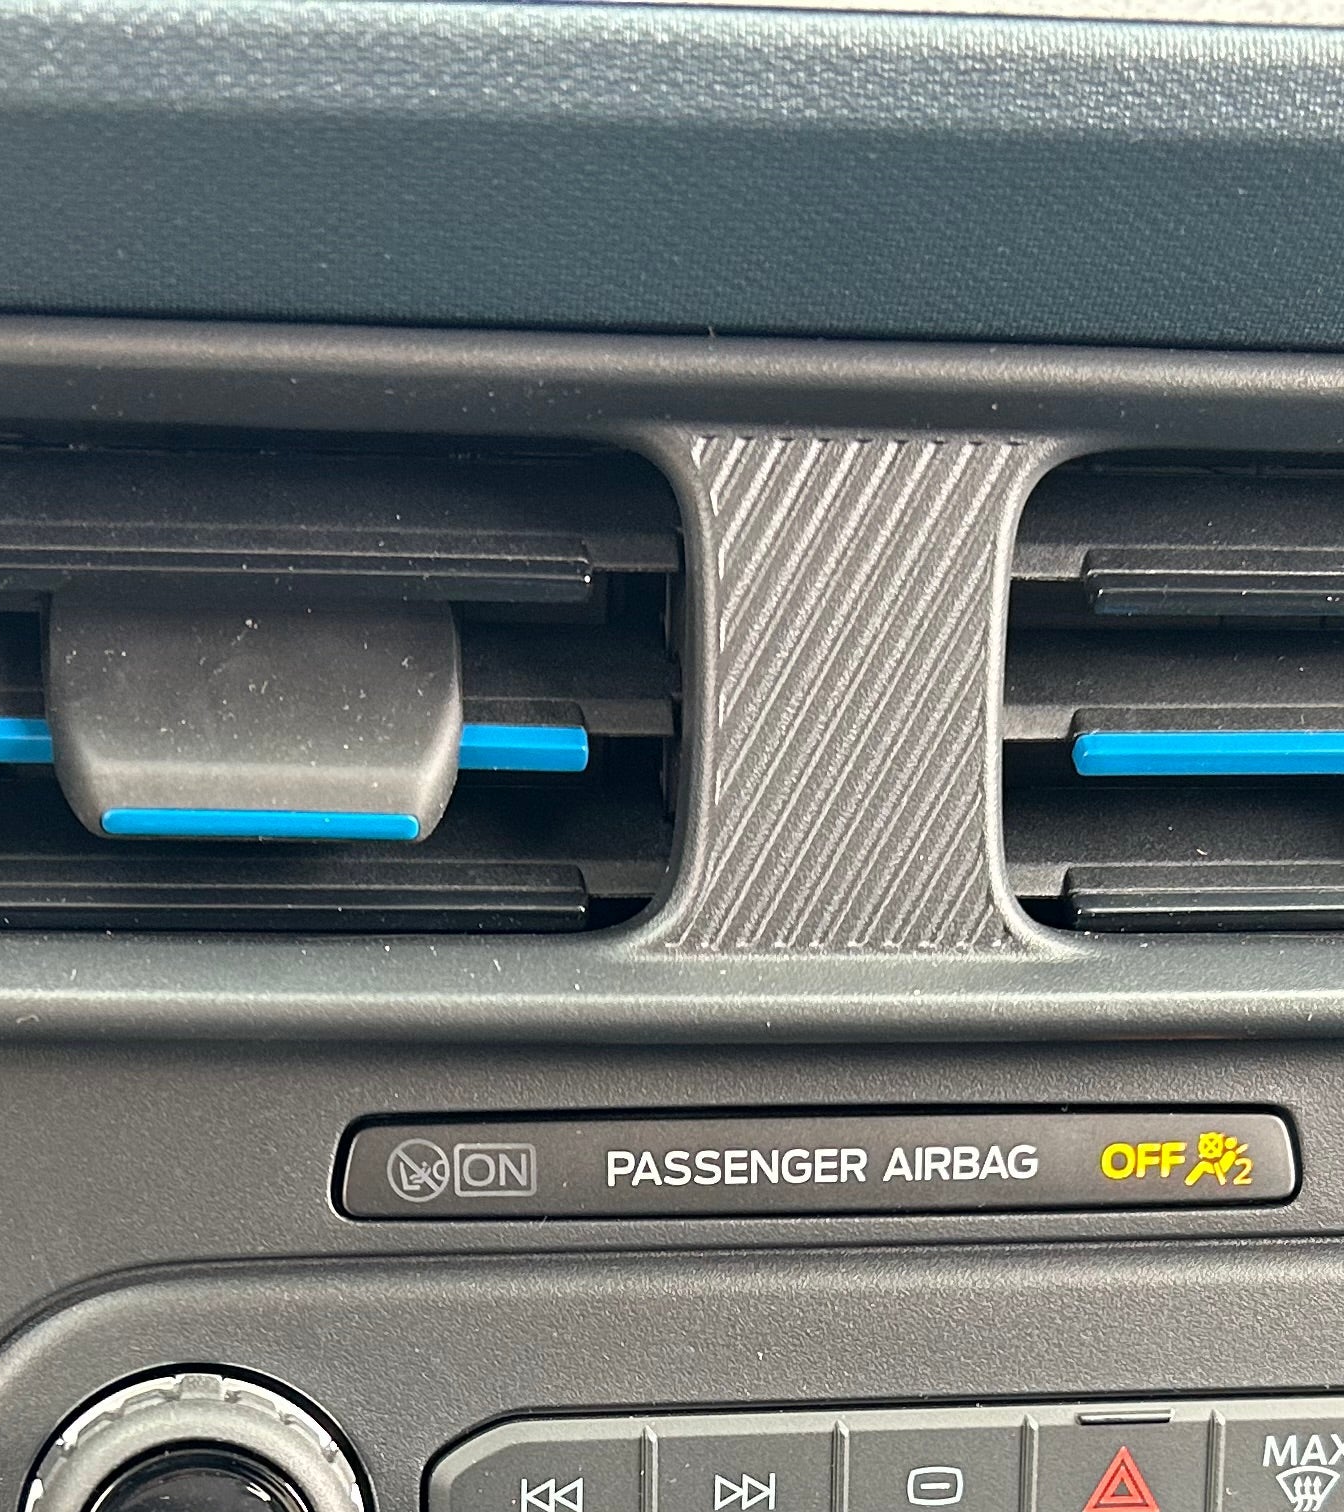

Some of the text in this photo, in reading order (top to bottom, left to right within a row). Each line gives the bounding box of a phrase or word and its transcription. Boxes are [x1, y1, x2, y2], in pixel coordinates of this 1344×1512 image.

[462, 1153, 528, 1187] ON
[605, 1144, 1039, 1188] PASSENGER AIRBAG
[1100, 1141, 1186, 1180] OFF
